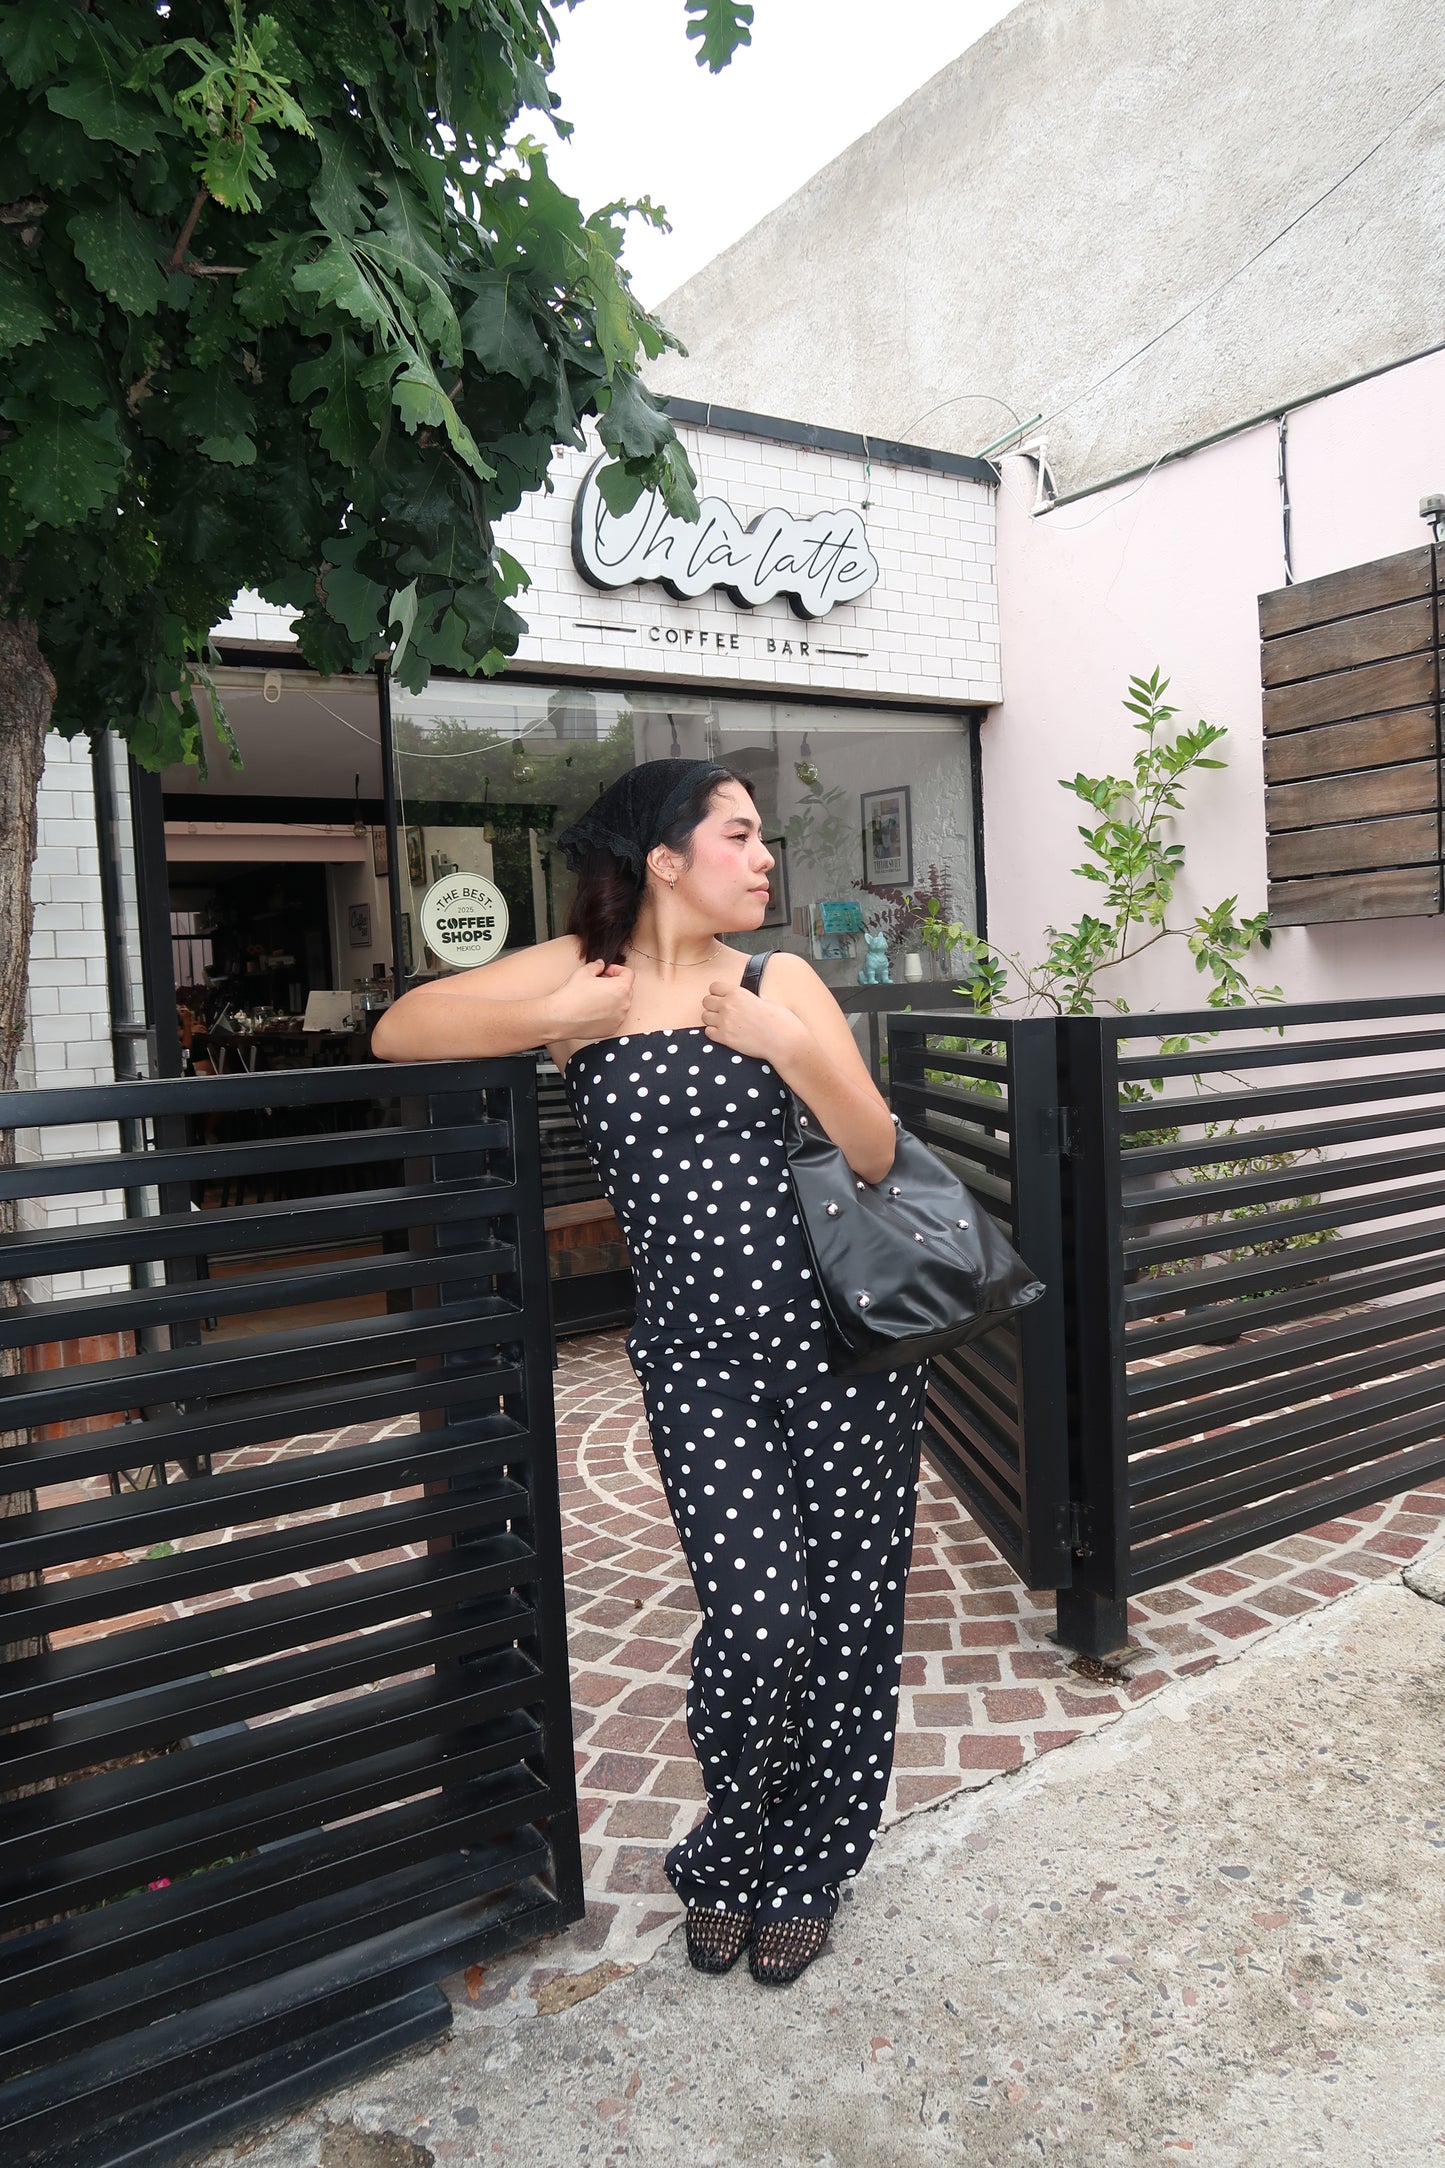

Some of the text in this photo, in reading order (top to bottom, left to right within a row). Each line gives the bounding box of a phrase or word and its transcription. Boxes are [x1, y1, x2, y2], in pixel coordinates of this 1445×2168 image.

[594, 486, 868, 599] Oh là latte
[649, 626, 810, 657] COFFEE BAR
[436, 887, 492, 908] THE BEST
[457, 906, 474, 914] 2025
[436, 916, 495, 930] COFFEE
[441, 930, 492, 944] SHOPS
